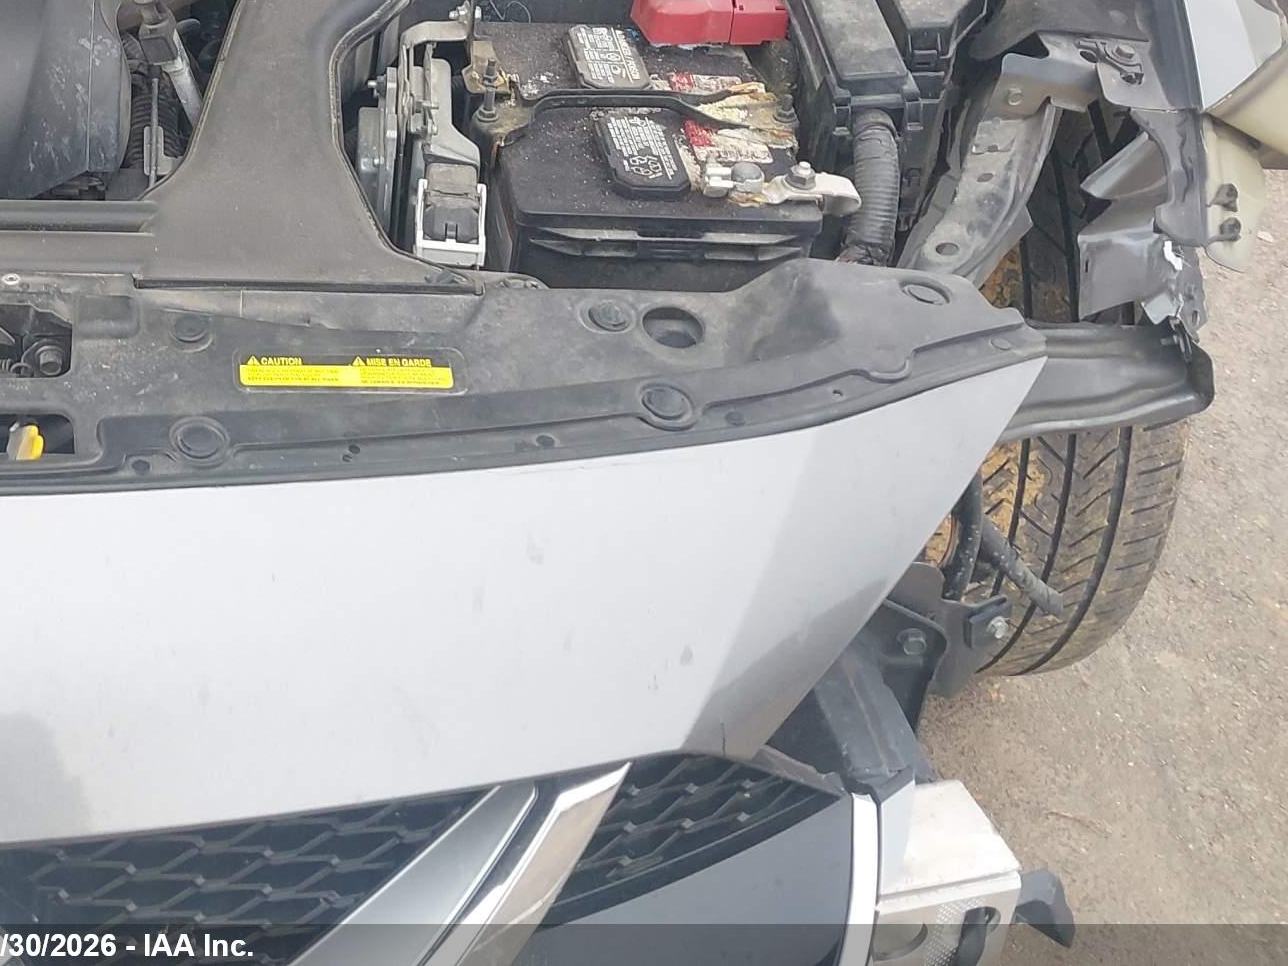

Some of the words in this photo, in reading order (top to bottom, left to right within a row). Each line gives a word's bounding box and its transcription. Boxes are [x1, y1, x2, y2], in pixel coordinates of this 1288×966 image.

[260, 357, 303, 366] CAUTION
[366, 358, 387, 367] MISE
[388, 358, 401, 367] EN
[402, 359, 432, 368] GARDE
